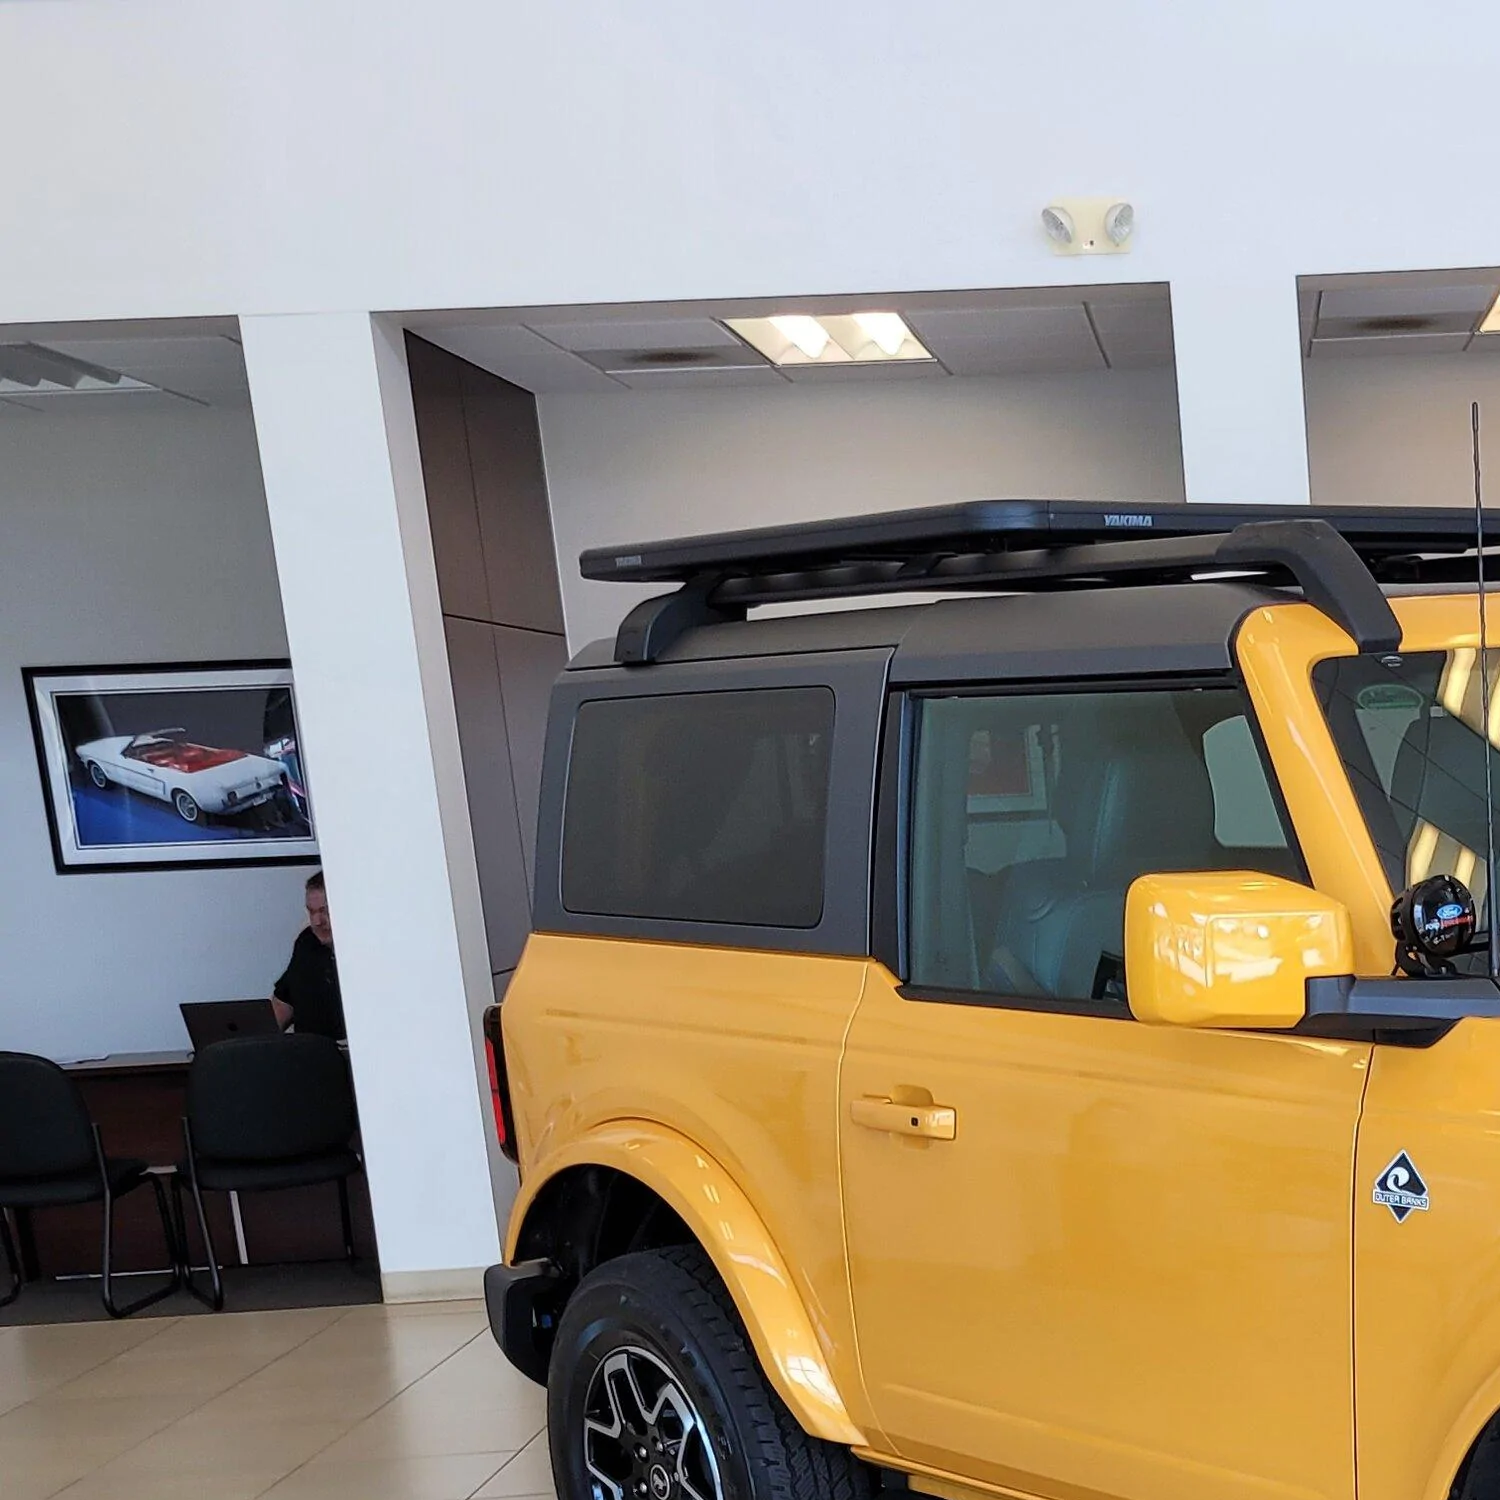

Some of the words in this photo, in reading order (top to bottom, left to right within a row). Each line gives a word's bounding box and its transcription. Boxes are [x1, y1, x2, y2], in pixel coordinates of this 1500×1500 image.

[1104, 514, 1152, 526] YAKIMA
[1375, 1192, 1400, 1204] OUTER
[1402, 1195, 1427, 1207] BANKS
